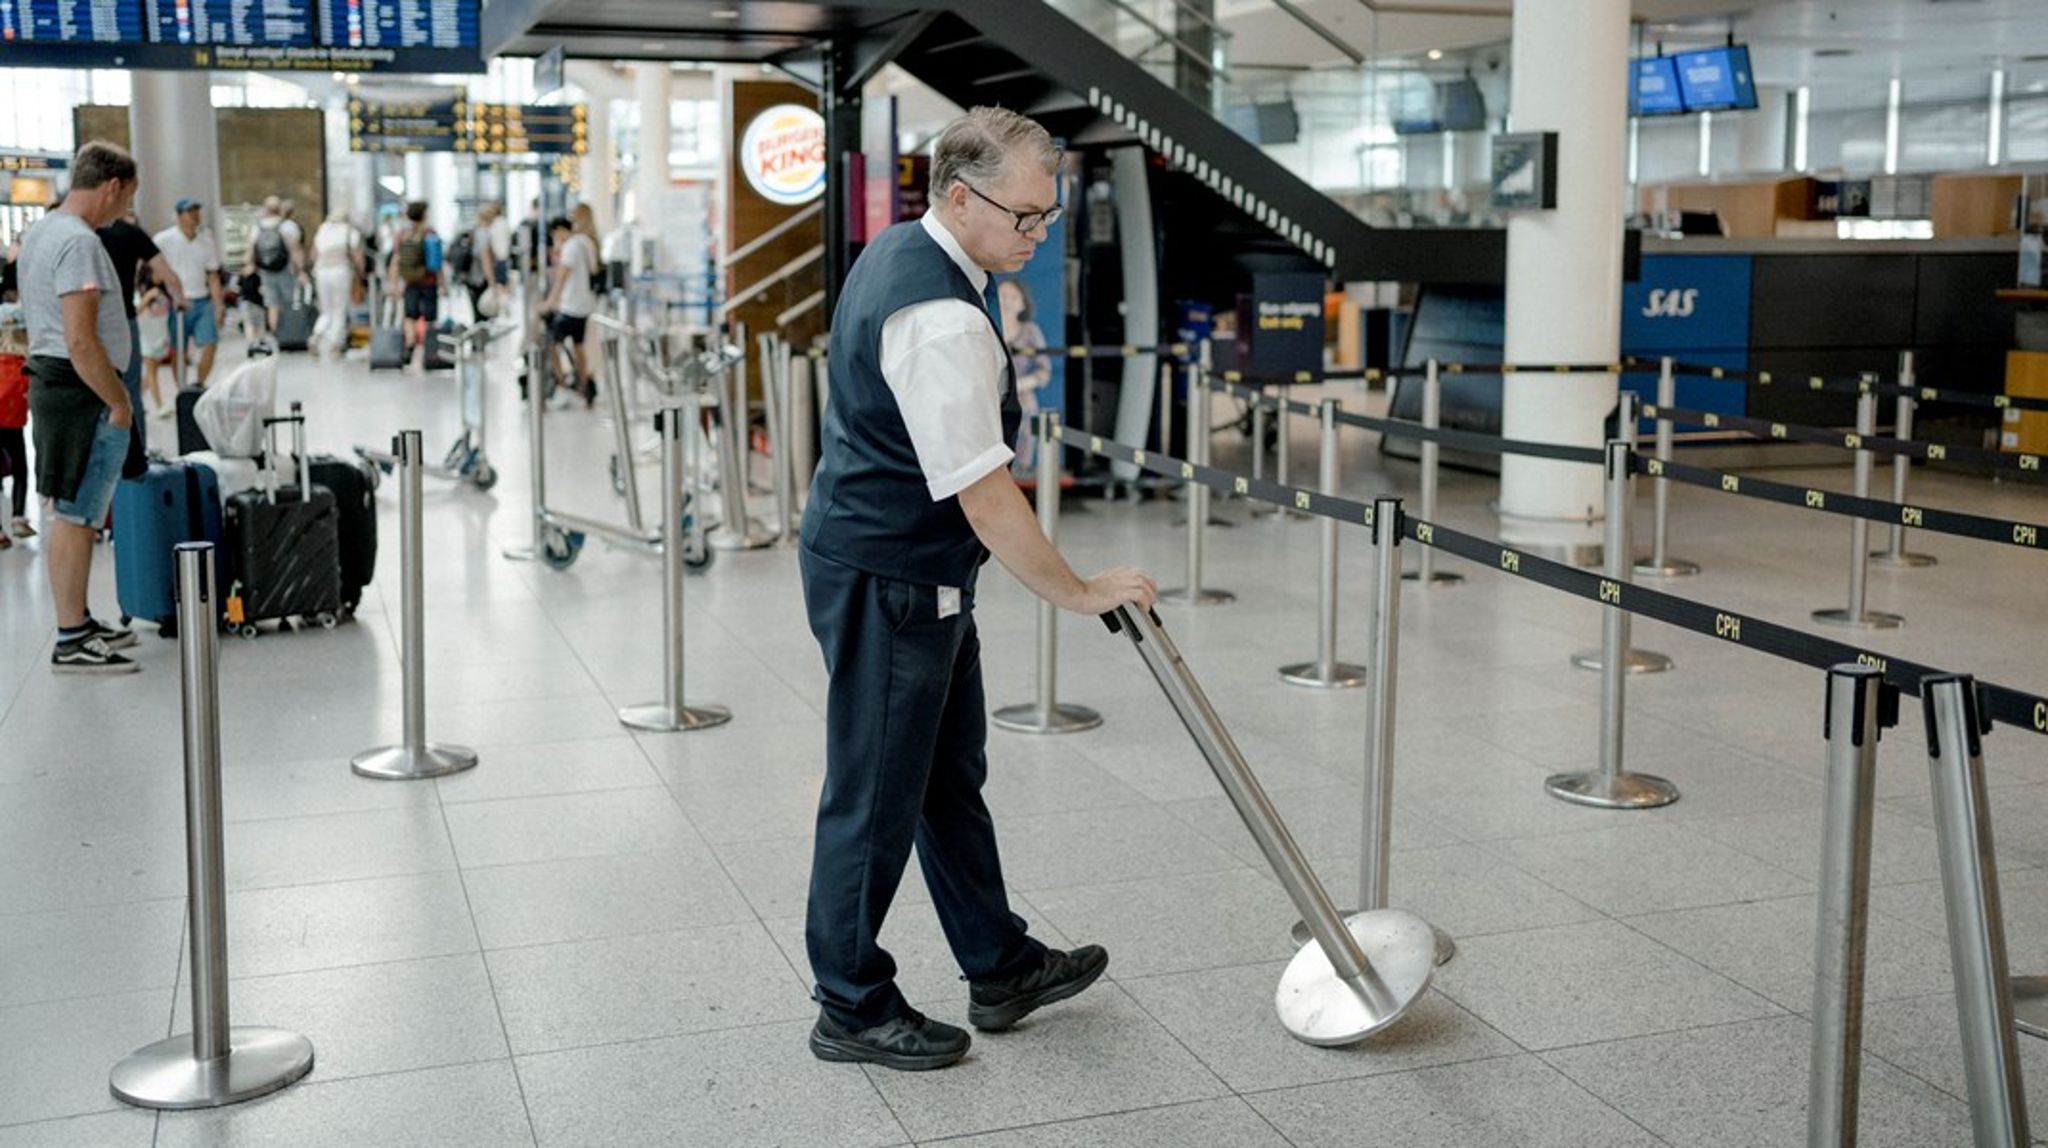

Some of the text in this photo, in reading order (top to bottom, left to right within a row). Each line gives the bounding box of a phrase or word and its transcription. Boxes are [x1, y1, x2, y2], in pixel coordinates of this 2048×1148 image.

[760, 142, 827, 176] KING
[1642, 288, 1699, 318] SAS
[1844, 433, 1861, 448] CPH
[1927, 444, 1946, 460] CPH
[2019, 454, 2039, 470] CPH
[1722, 473, 1739, 491] CPH
[1805, 489, 1825, 508] CPH
[1902, 506, 1922, 526] CPH
[2012, 523, 2037, 546] CPH
[1416, 522, 1434, 544] CPH
[1500, 550, 1520, 572] CPH
[1600, 580, 1621, 604] CPH
[1716, 613, 1741, 641] CPH
